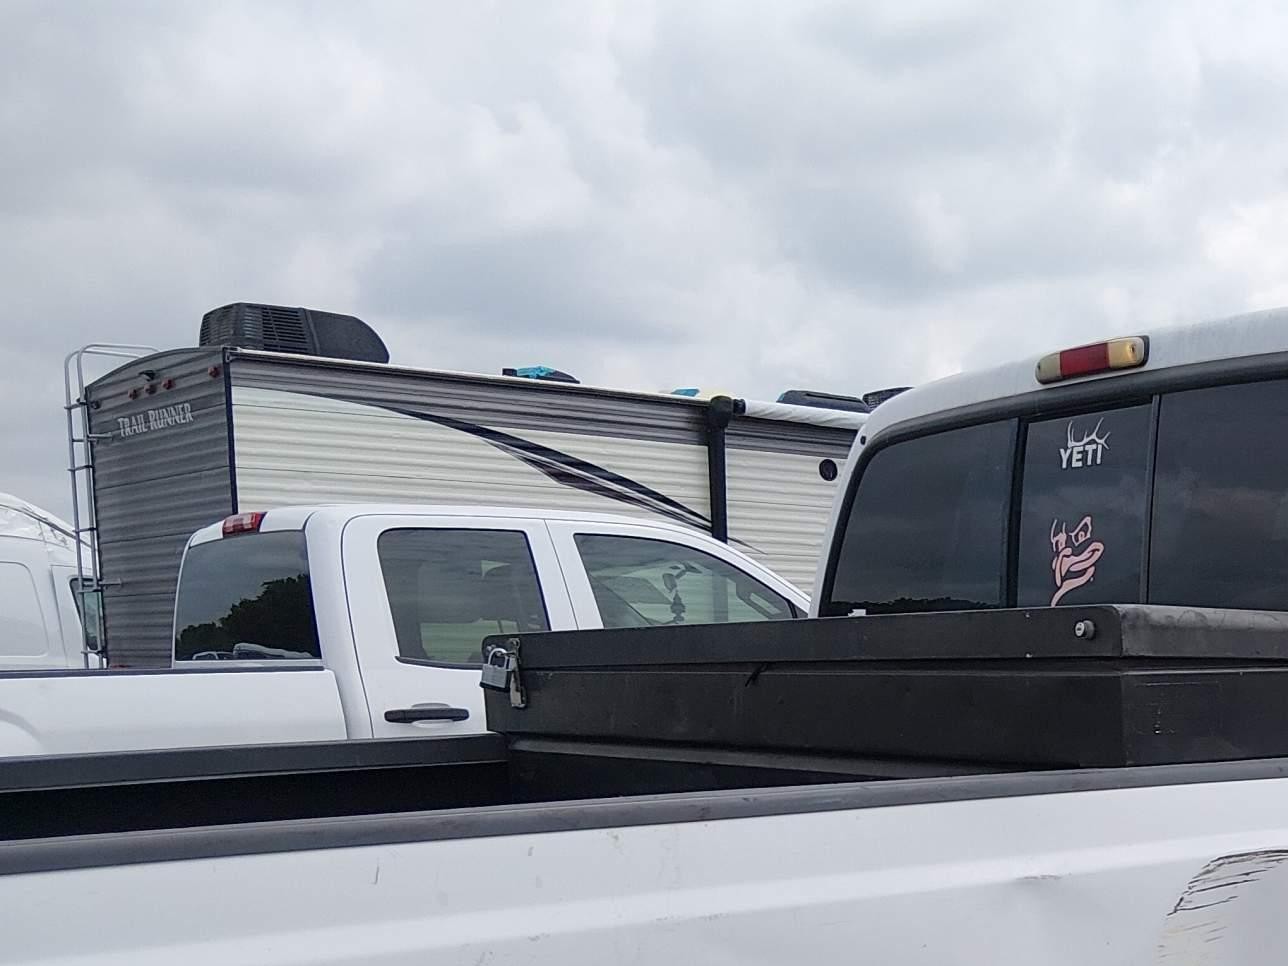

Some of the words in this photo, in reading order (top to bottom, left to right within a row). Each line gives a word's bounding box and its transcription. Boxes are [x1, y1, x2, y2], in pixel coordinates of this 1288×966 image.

[118, 415, 148, 437] TRAIL
[148, 403, 194, 430] RUNNER
[1060, 444, 1103, 469] YETI
